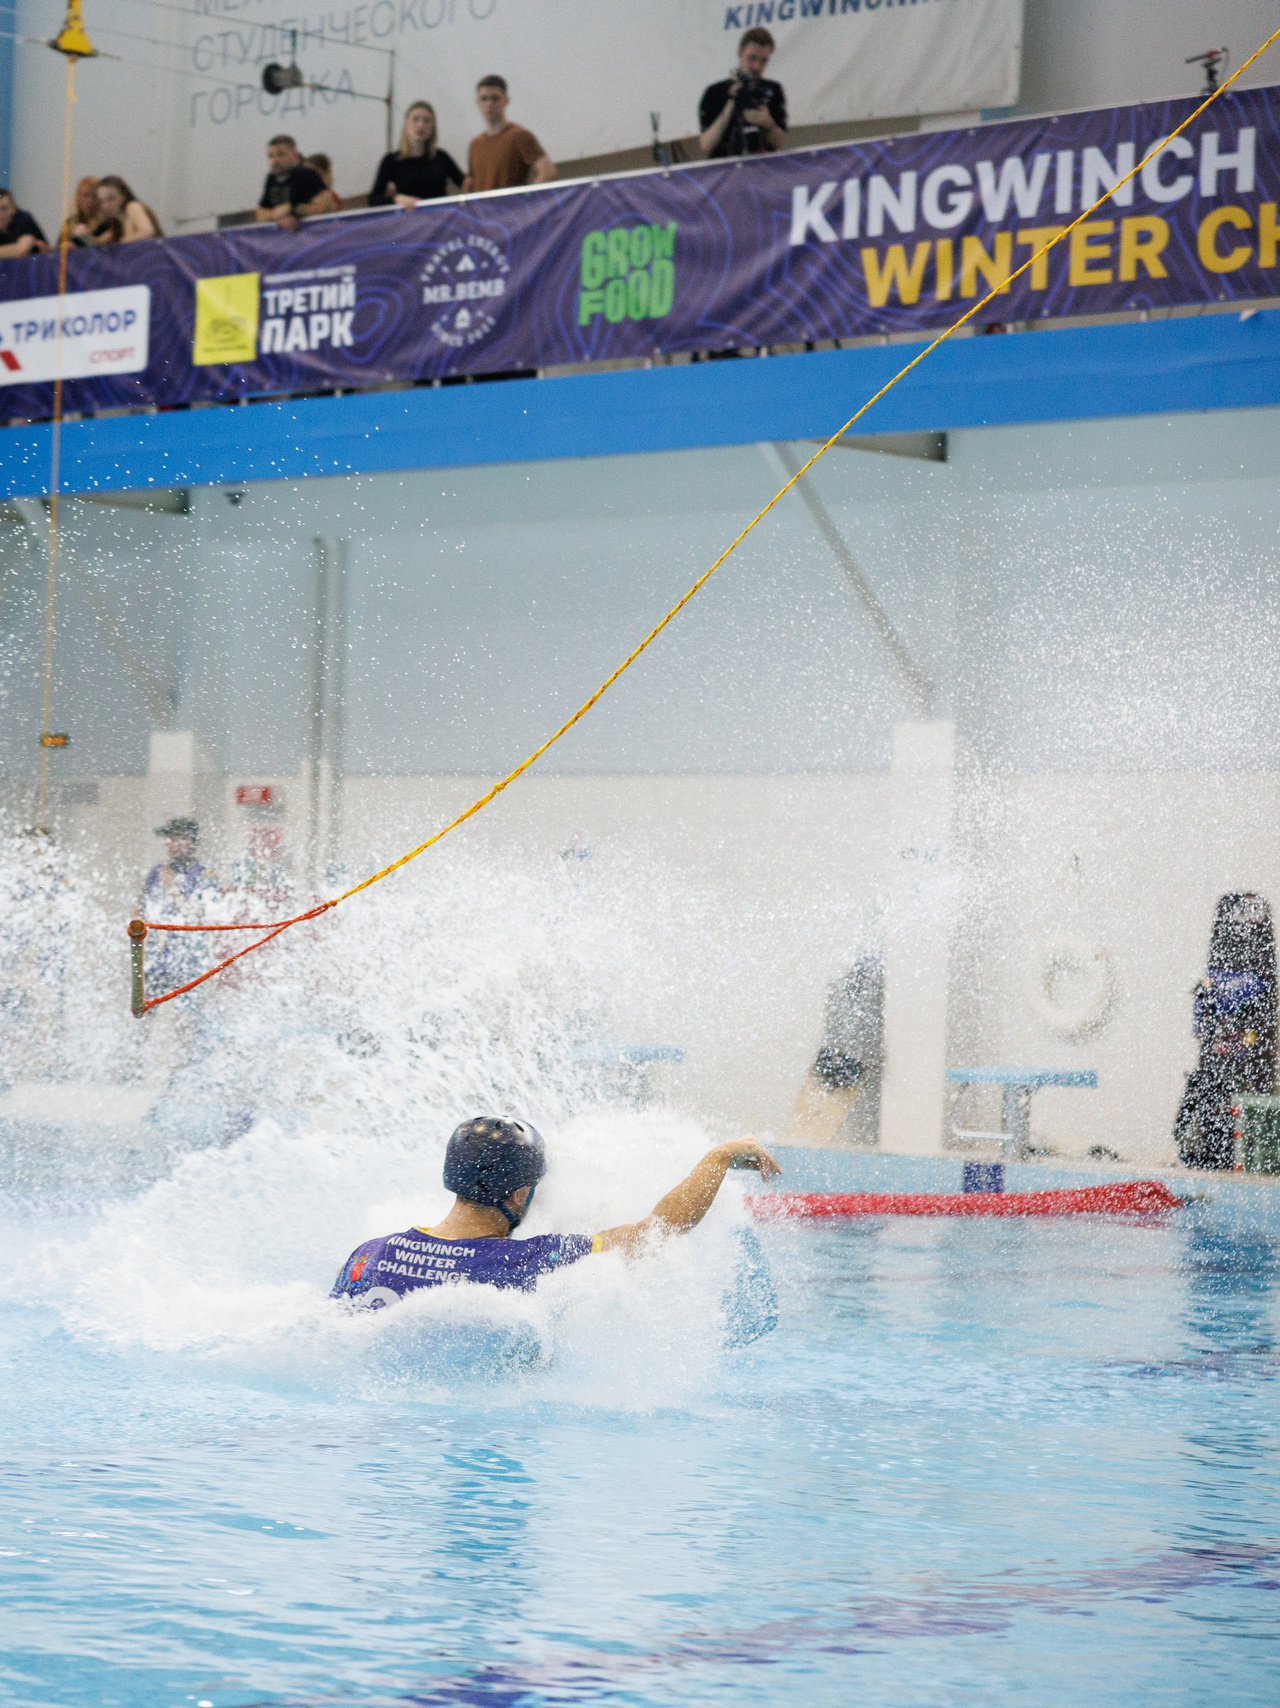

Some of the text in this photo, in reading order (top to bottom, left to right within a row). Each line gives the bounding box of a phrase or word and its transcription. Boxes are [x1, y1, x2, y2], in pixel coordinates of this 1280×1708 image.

[189, 68, 355, 128] ГОРОДКА
[789, 128, 1255, 246] KINGWINCH
[581, 221, 677, 290] GROW
[861, 216, 1170, 307] WINTER
[263, 276, 356, 317] ТРЕТИЙ
[578, 257, 675, 326] FOOD
[13, 309, 137, 343] ТРИКОЛОР
[260, 310, 356, 355] ПАРК
[386, 1236, 476, 1258] KINGWINCH
[395, 1248, 457, 1269] WINTER
[377, 1259, 471, 1283] CHALLENGE
